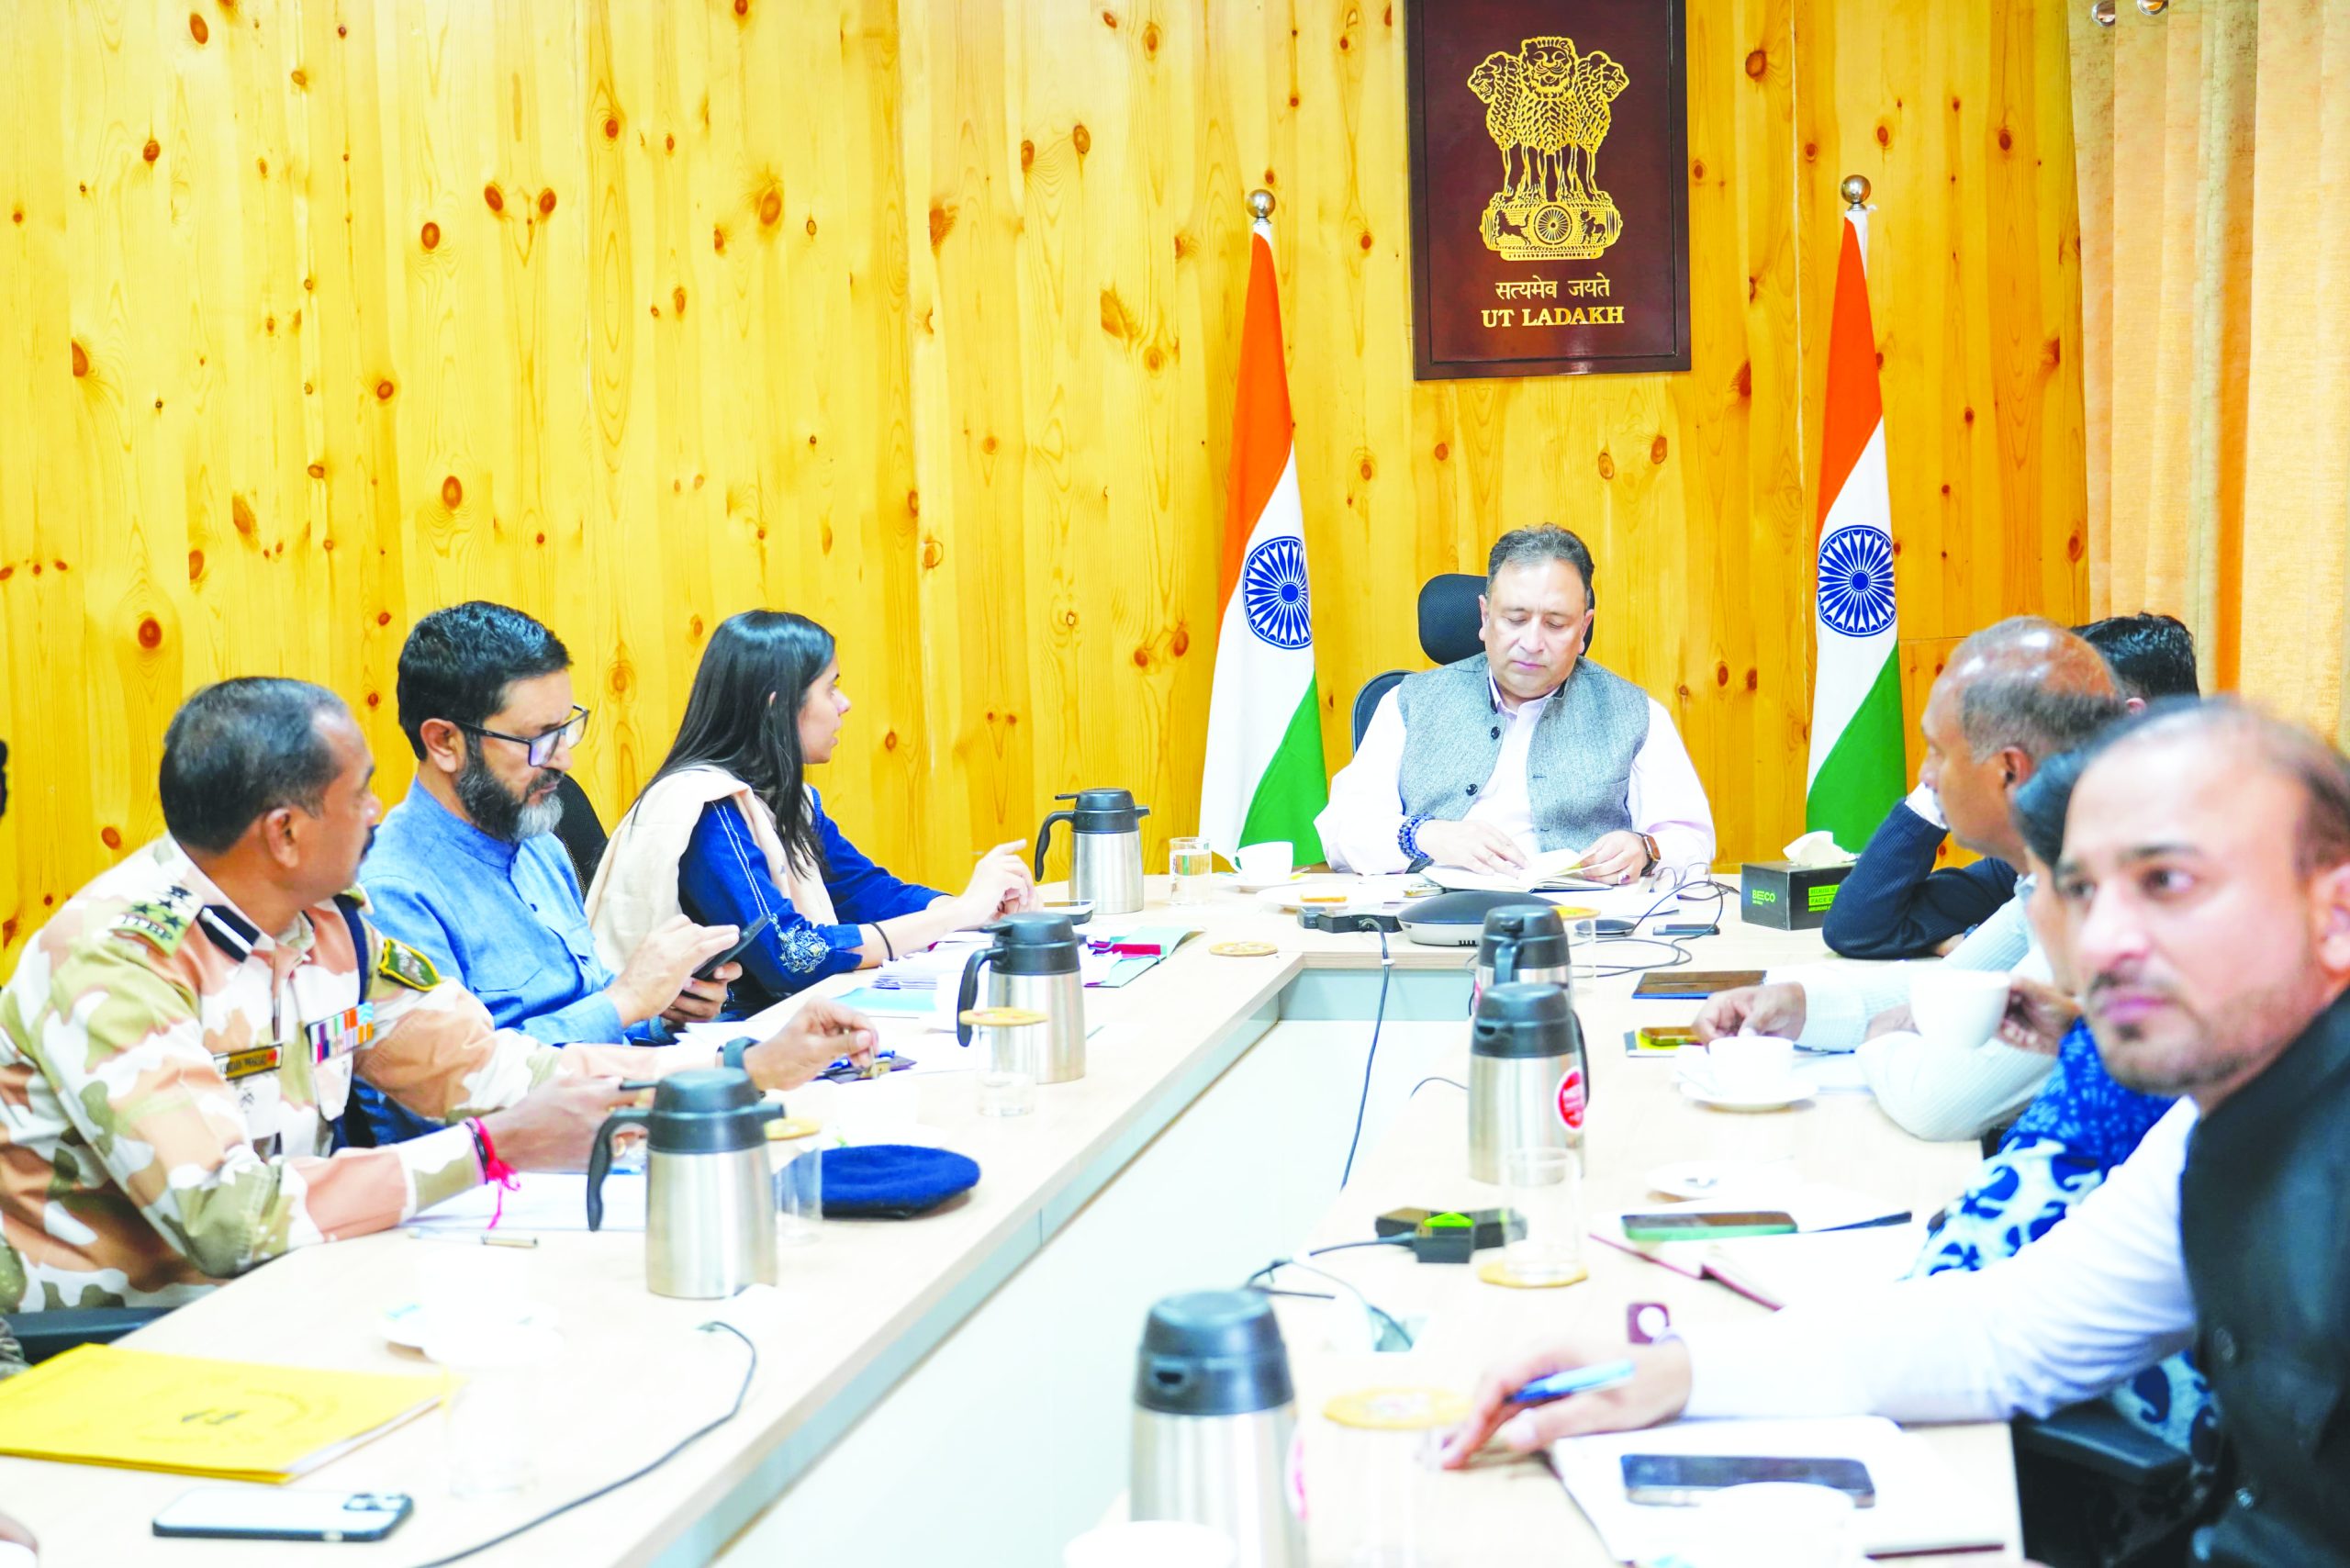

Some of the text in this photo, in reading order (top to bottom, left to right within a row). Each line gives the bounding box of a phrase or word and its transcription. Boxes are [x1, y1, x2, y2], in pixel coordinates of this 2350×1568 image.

[1494, 272, 1610, 300] सत्यमेव जयते
[1481, 306, 1625, 328] UT LADAKH
